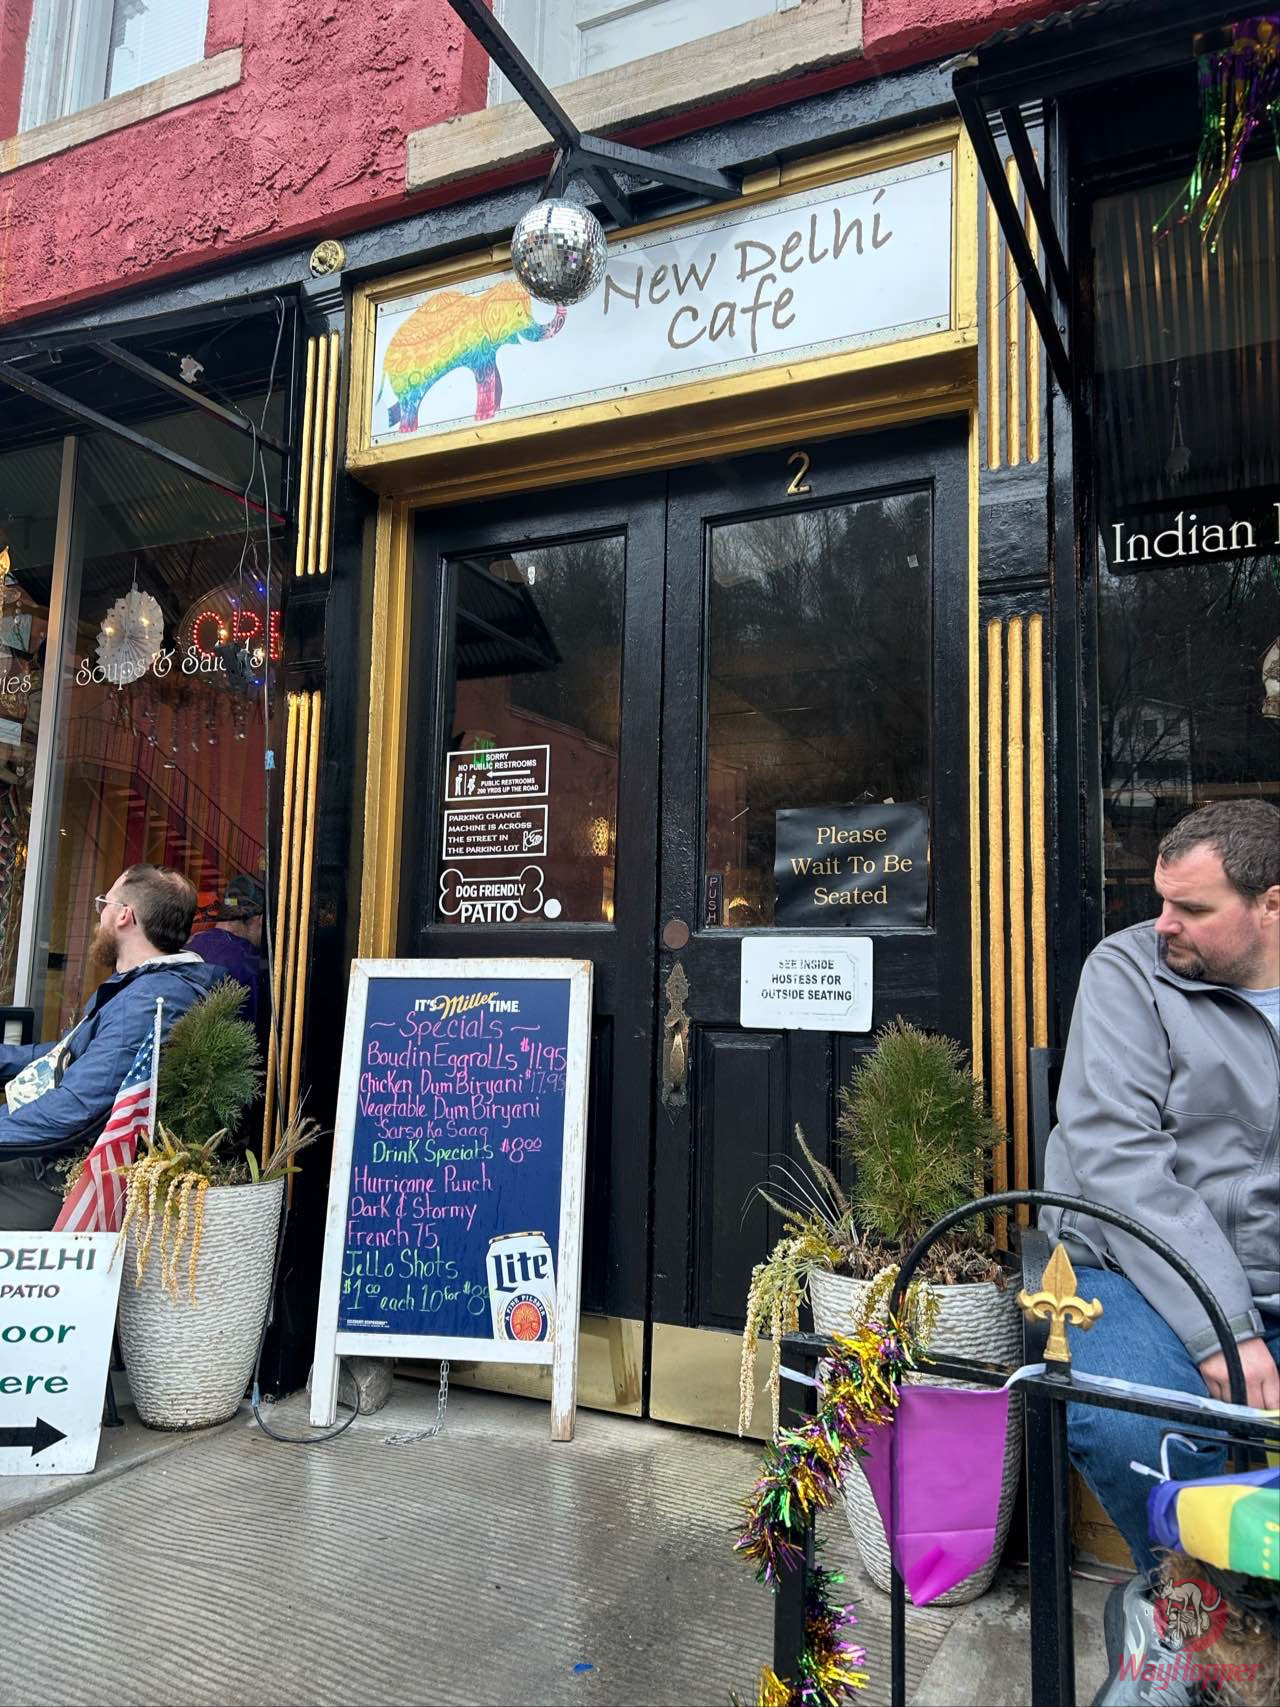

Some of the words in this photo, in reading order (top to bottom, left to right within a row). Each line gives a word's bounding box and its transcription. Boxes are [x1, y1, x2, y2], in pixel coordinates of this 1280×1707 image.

[604, 252, 717, 315] New
[735, 188, 893, 283] Delhi
[667, 272, 796, 353] Cafe
[786, 450, 812, 496] 2
[1111, 511, 1257, 564] Indian
[76, 657, 147, 690] Soups
[152, 649, 176, 678] &
[0, 669, 32, 695] ies
[458, 764, 468, 772] NO
[469, 762, 493, 771] PUBLIC
[495, 759, 537, 769] RESTROOMS
[486, 752, 509, 761] SORRY
[481, 779, 500, 787] PUBLIC
[501, 777, 535, 786] RESTROOMS
[502, 786, 511, 794] UP
[511, 785, 522, 793] THE
[523, 784, 539, 792] ROAD
[448, 813, 484, 822] PARKING
[486, 811, 521, 820] CHANGE
[448, 824, 486, 832] MACHINE
[488, 823, 497, 831] IS
[498, 822, 532, 830] ACROSS
[448, 836, 465, 844] THE
[466, 834, 497, 843] STREET
[815, 826, 887, 845] Please
[448, 847, 464, 855] THE
[465, 845, 501, 854] PARKING
[503, 844, 520, 852] LOT
[790, 857, 842, 876] Wait
[847, 855, 876, 874] To
[882, 854, 913, 873] Be
[455, 885, 478, 898] DOG
[479, 883, 526, 897] FRIENDLY
[708, 877, 719, 923] PUSH
[813, 885, 888, 906] Seated
[460, 903, 518, 924] PATIO
[799, 959, 835, 970] INSIDE
[771, 974, 818, 985] HOSTESS
[820, 974, 842, 986] FOR
[414, 999, 436, 1012] IT'S
[434, 991, 499, 1020] Miller
[761, 989, 805, 1000] OUTSIDE
[807, 989, 852, 1001] SEATING
[367, 1040, 432, 1068] Boudin
[420, 1069, 452, 1095] Dum
[455, 1070, 523, 1104] Biryani
[359, 1093, 428, 1126] Vegetable
[434, 1096, 470, 1121] Dum
[471, 1093, 541, 1128] Biryani
[353, 1165, 437, 1194] Hurricane
[444, 1162, 494, 1194] Punch
[412, 1194, 477, 1231] Stormy
[346, 1218, 409, 1248] French
[411, 1223, 439, 1249] 75
[399, 1246, 459, 1279] Shots
[490, 1251, 549, 1293] Lite
[0, 1283, 61, 1299] PATIO
[379, 1283, 415, 1312] each
[419, 1283, 444, 1313] 10
[443, 1285, 461, 1301] for
[1, 1323, 76, 1344] oor
